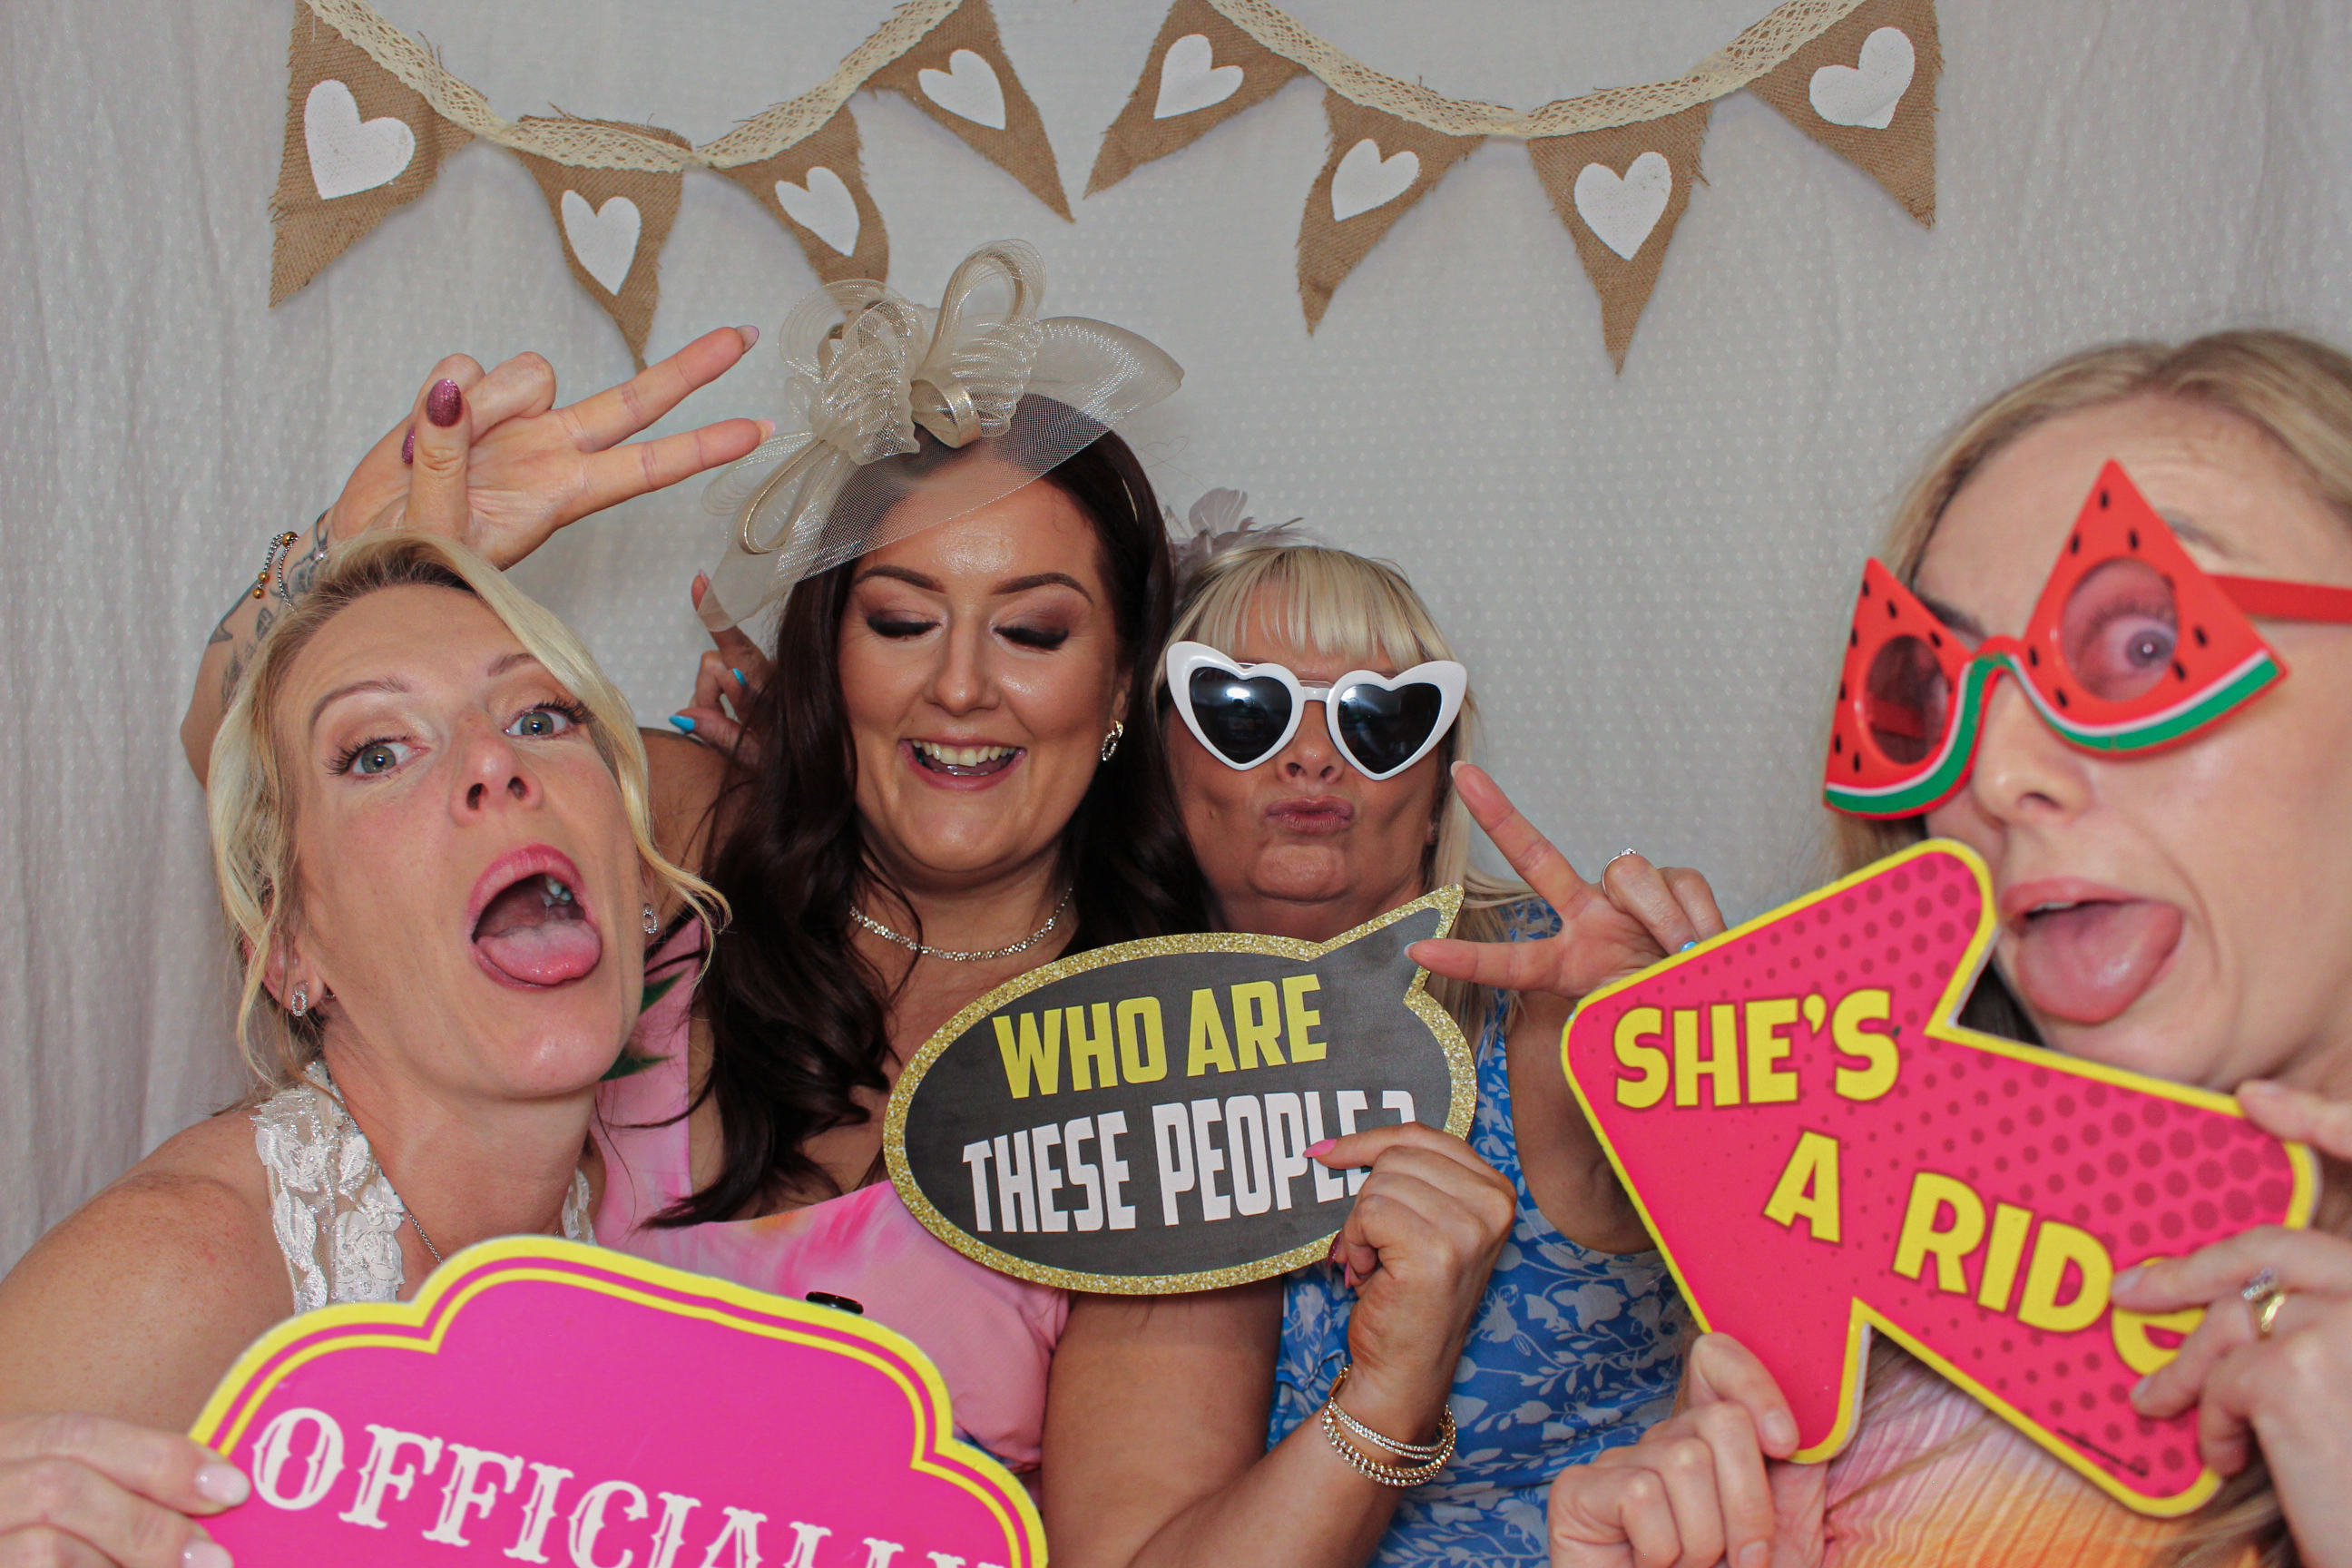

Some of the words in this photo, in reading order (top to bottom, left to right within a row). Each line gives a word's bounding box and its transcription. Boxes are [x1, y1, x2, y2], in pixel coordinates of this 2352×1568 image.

[992, 996, 1169, 1098] WHO
[1187, 974, 1327, 1077] ARE
[1613, 989, 1900, 1110] SHE'S
[962, 1110, 1136, 1232] THESE
[1763, 1131, 1842, 1243] A
[251, 1407, 1005, 1568] OFFICIA
